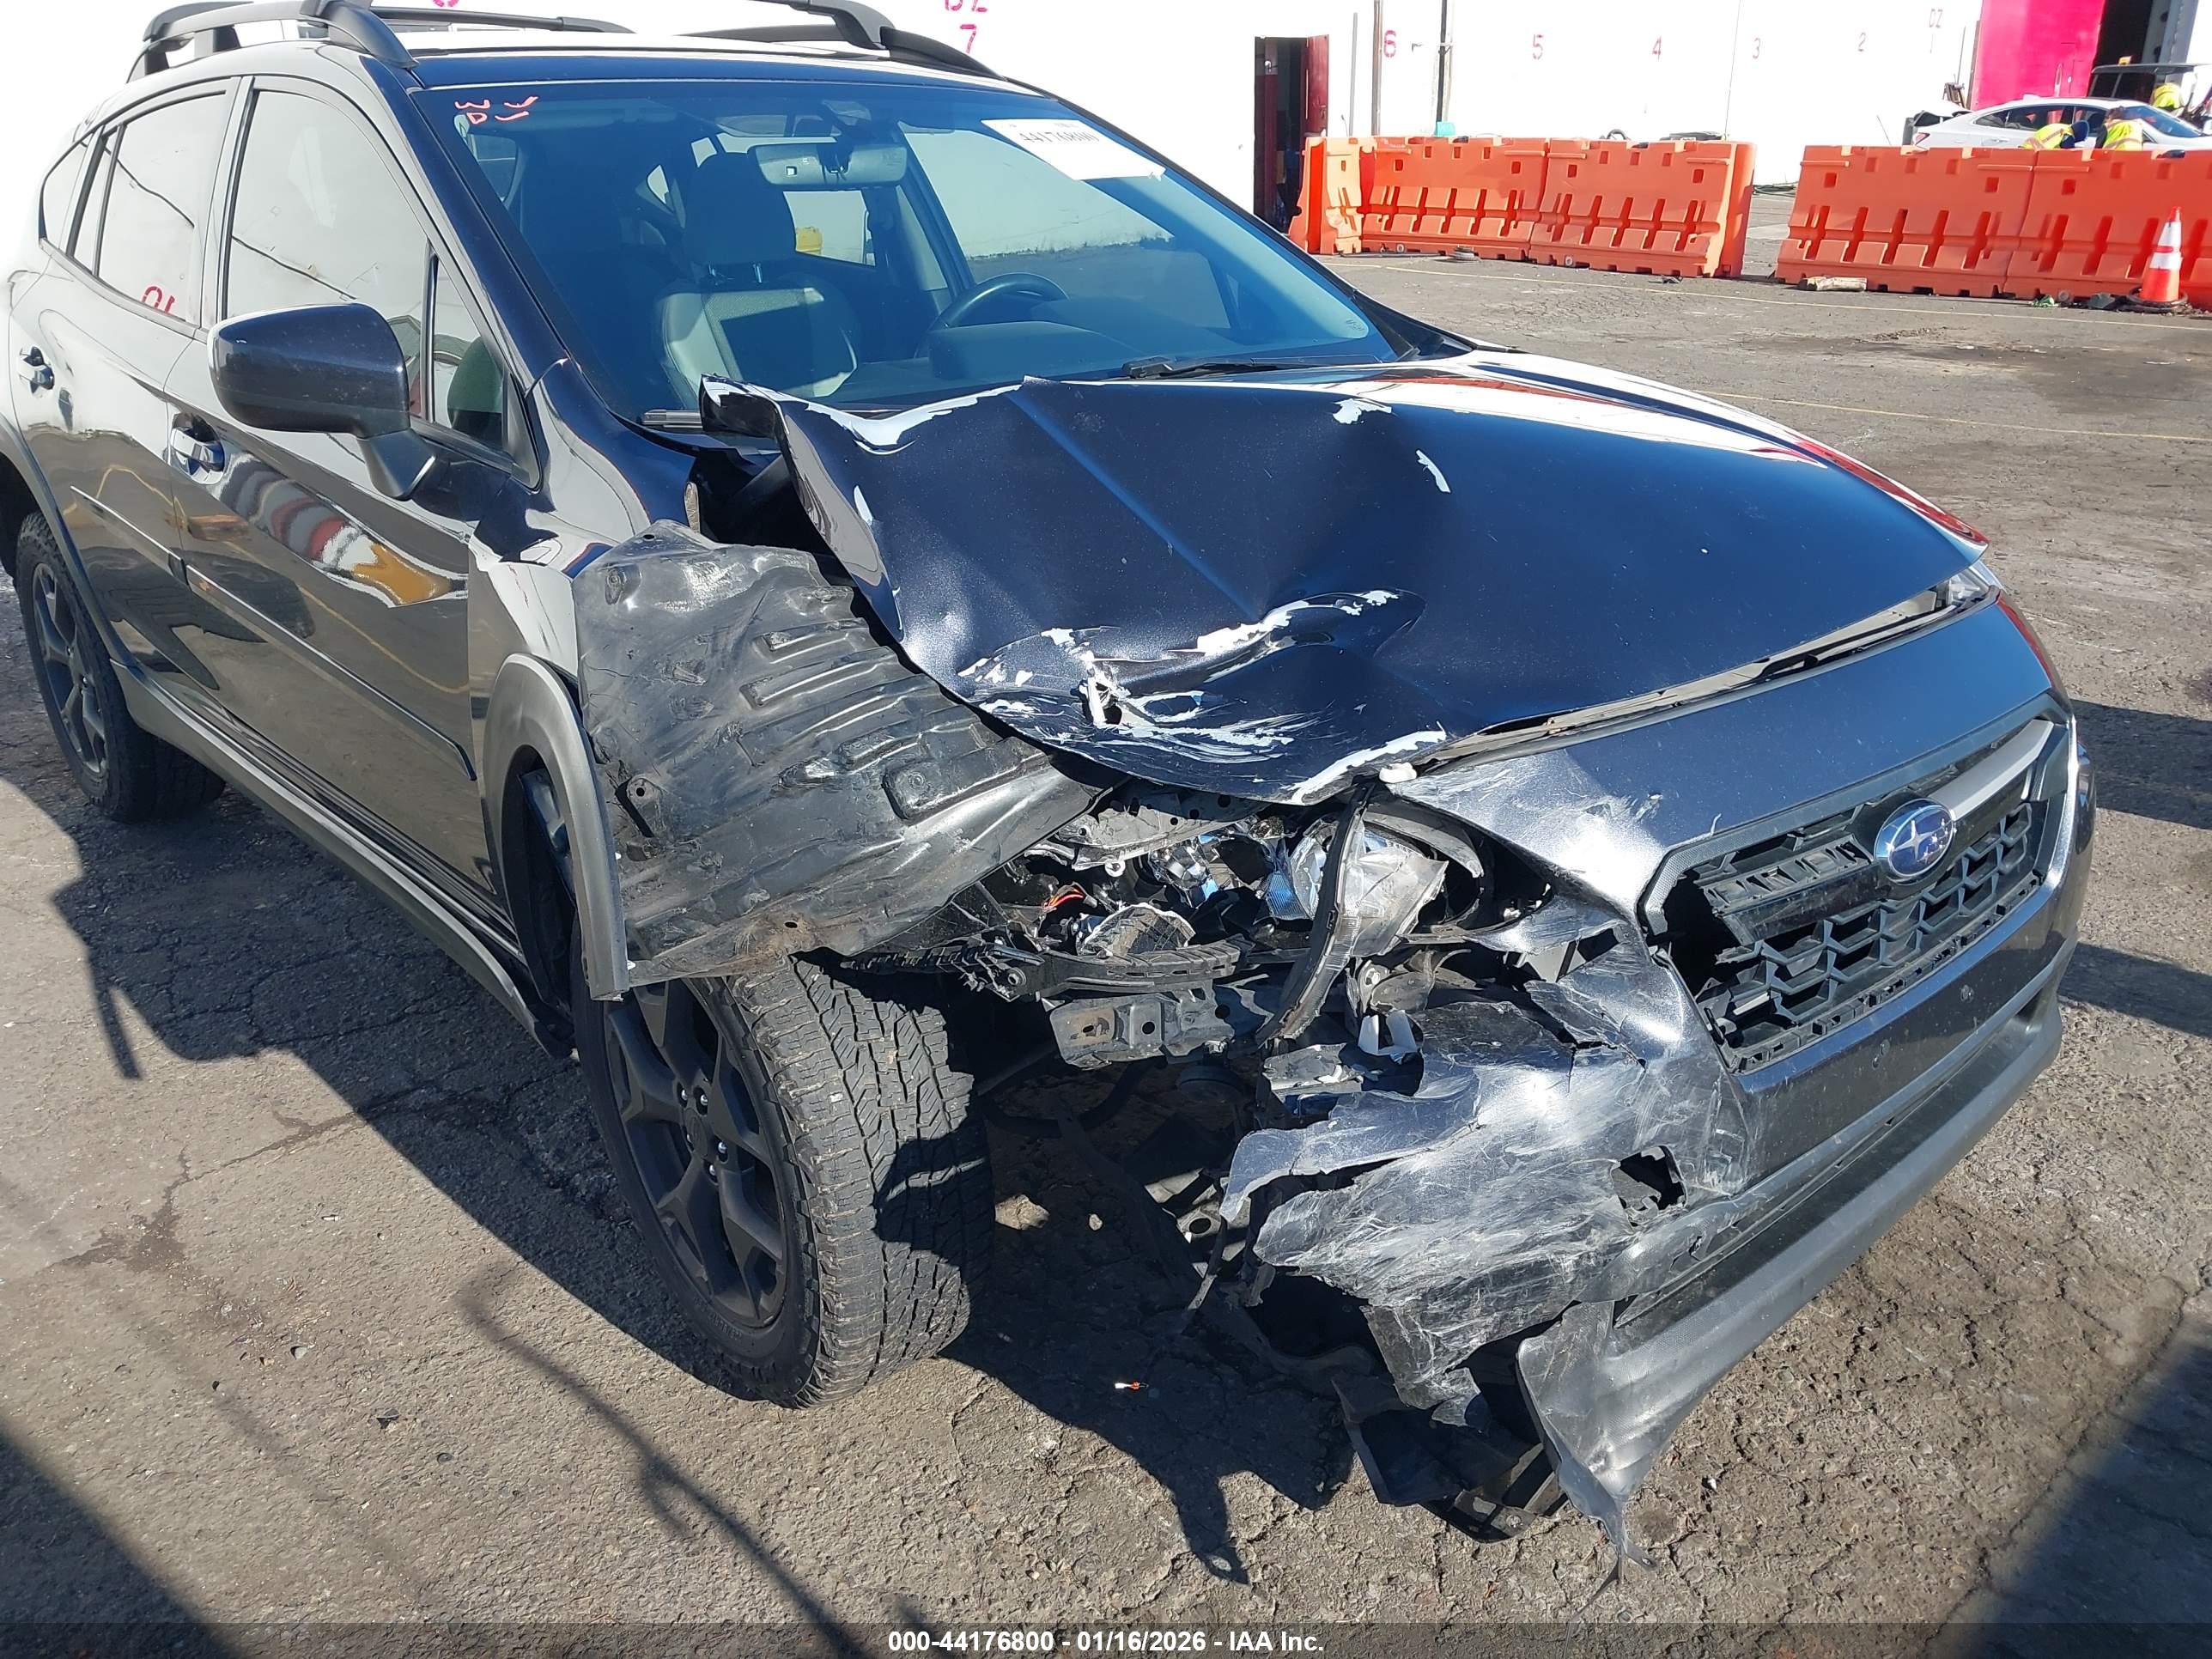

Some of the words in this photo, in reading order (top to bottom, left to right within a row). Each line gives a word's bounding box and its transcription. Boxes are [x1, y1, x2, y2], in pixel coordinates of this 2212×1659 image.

[960, 24, 976, 54] 7
[1383, 30, 1396, 58] 6
[1532, 34, 1543, 60] 5
[1652, 36, 1662, 61] 4
[1753, 37, 1760, 59] 3
[1858, 32, 1866, 52] 2
